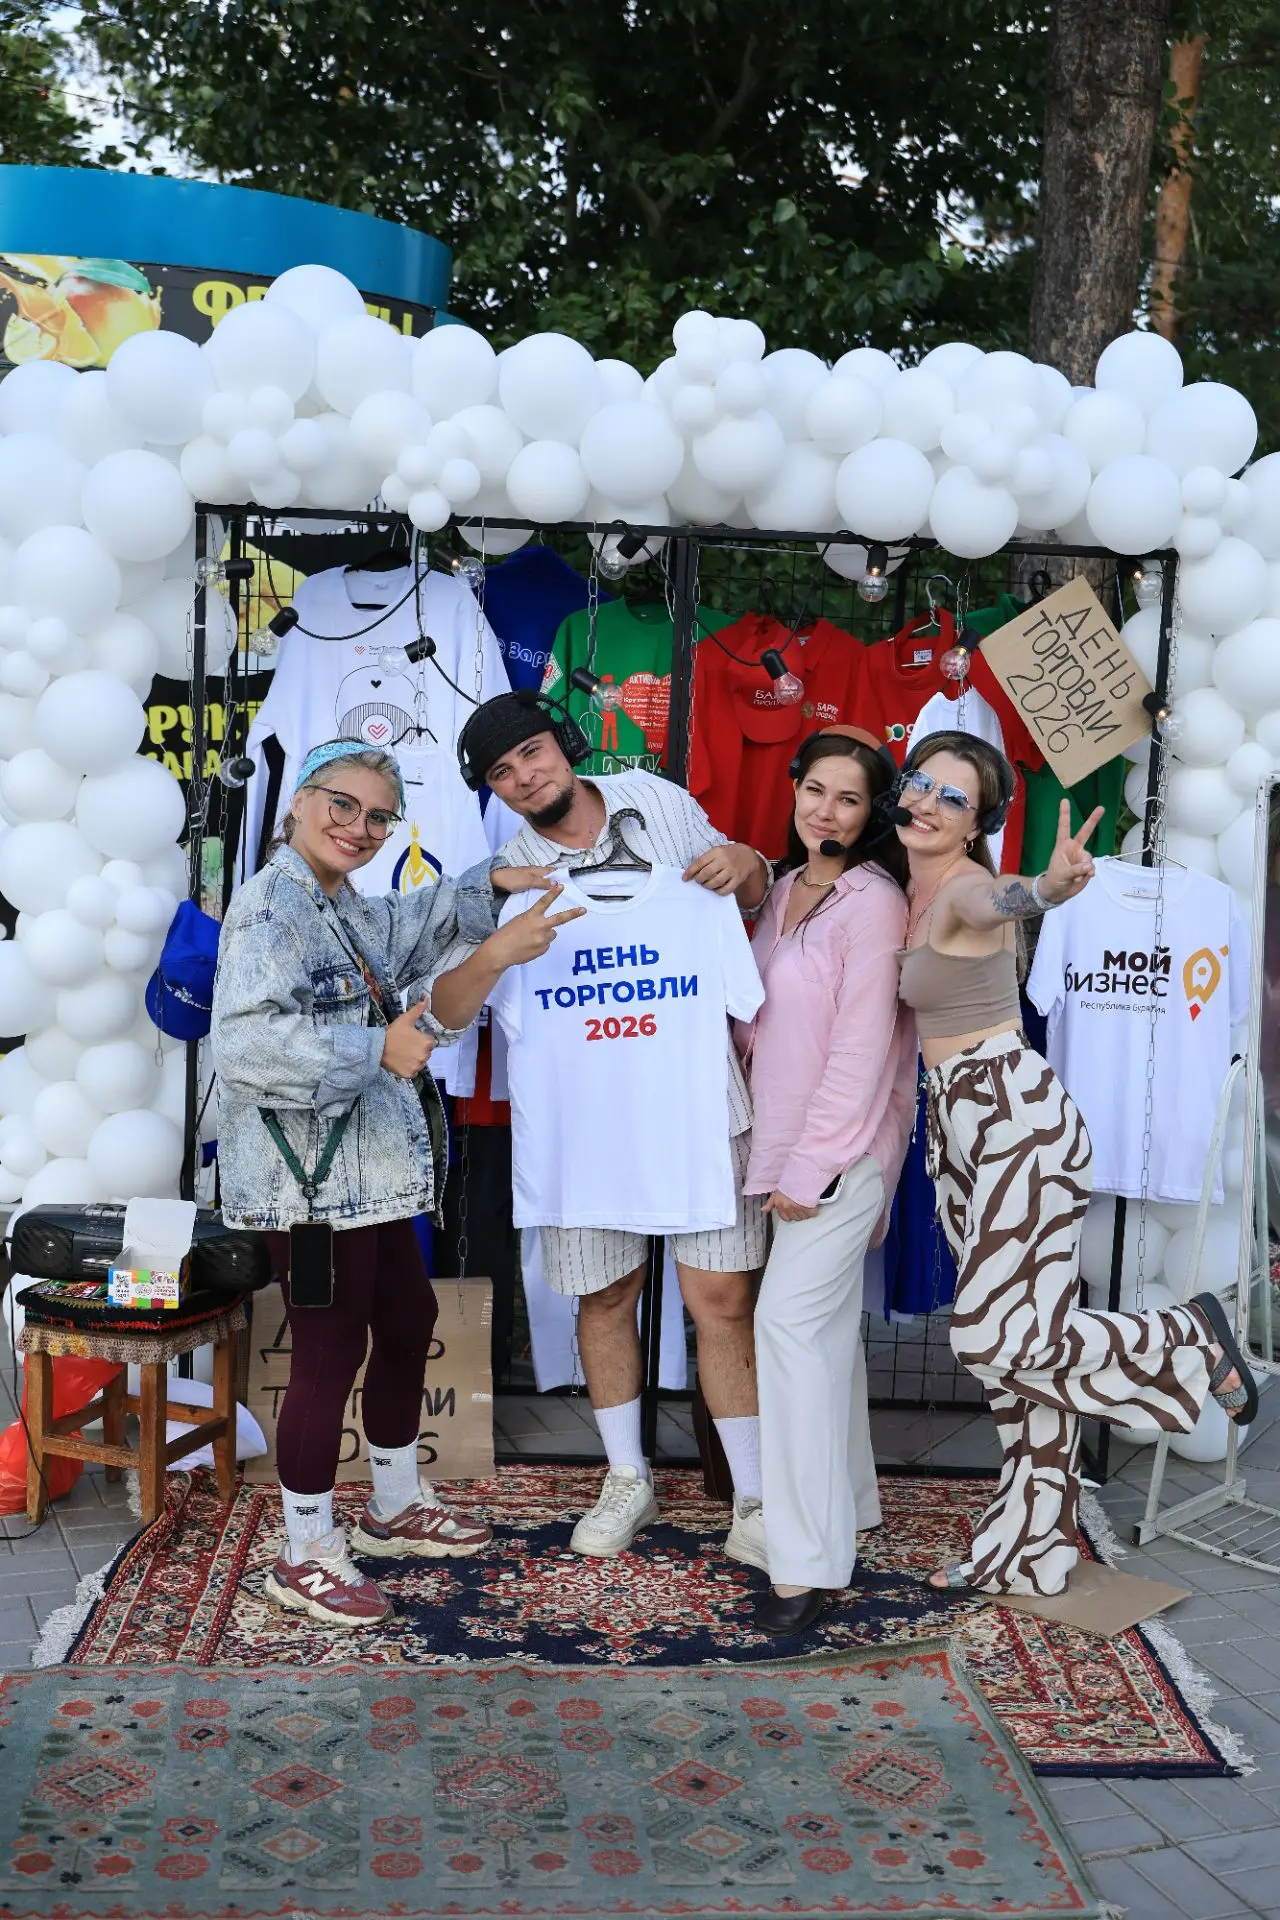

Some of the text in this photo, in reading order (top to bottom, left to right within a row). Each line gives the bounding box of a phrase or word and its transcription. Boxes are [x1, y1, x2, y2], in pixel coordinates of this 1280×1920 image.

[1054, 606, 1136, 700] ДЕНЬ
[1022, 609, 1122, 744] ТОРГОВЛИ
[1006, 662, 1085, 753] 2026
[572, 944, 660, 976] ДЕНЬ
[535, 975, 698, 1010] ТОРГОВЛИ
[1064, 962, 1170, 997] бизнес
[584, 1013, 658, 1042] 2026
[298, 1571, 336, 1597] N
